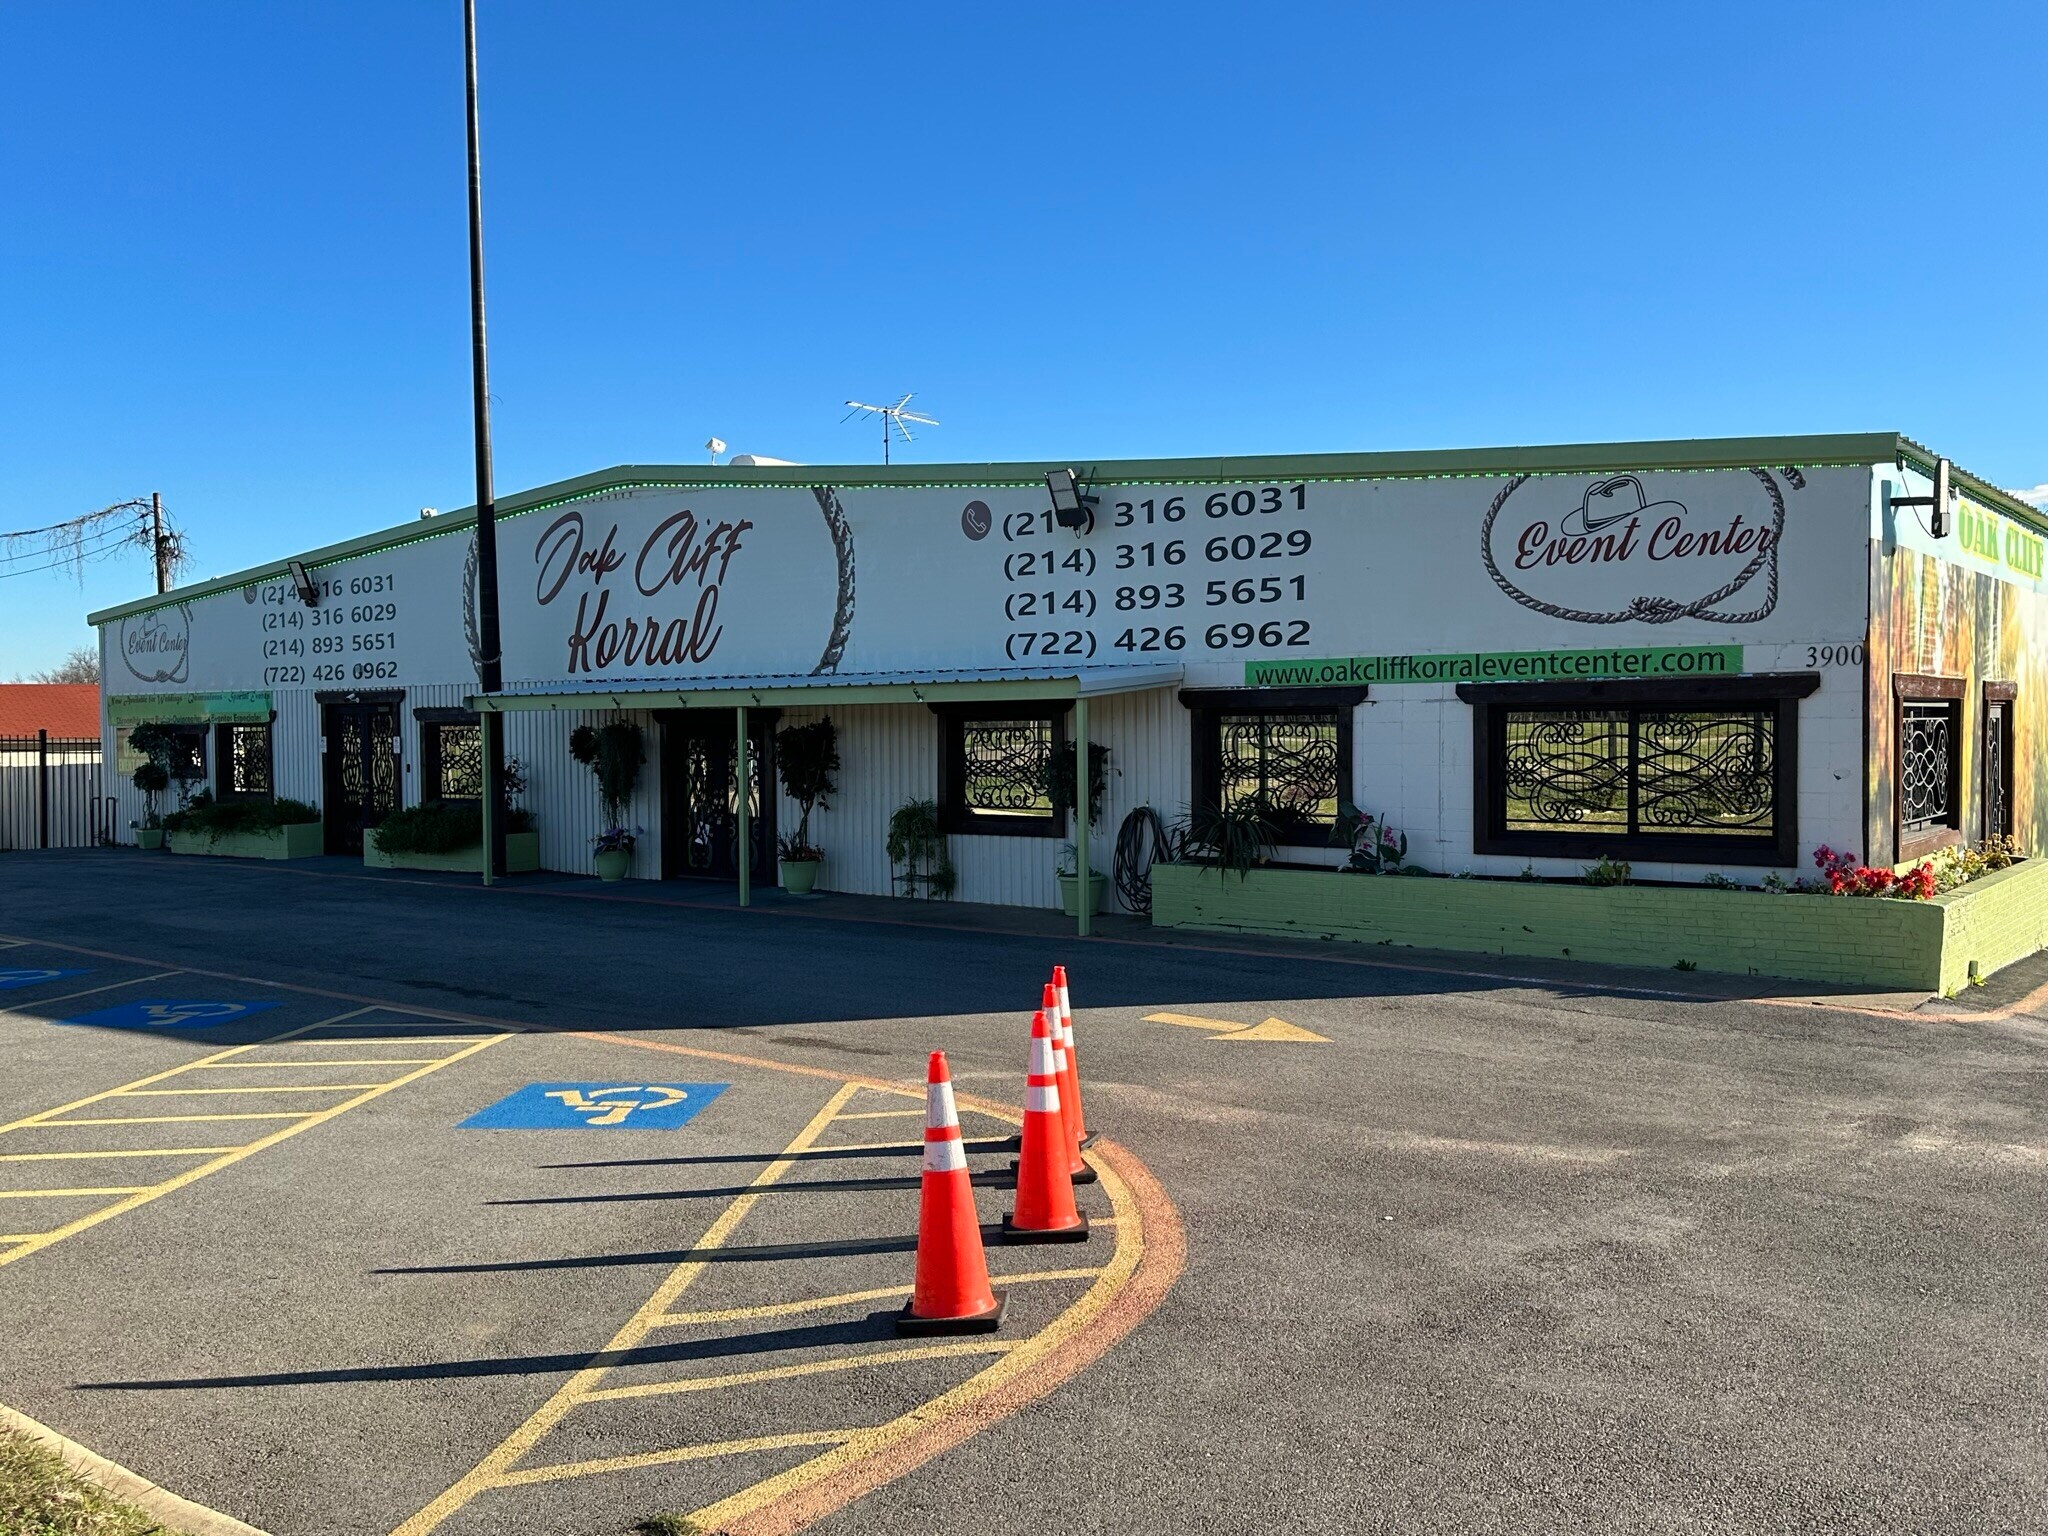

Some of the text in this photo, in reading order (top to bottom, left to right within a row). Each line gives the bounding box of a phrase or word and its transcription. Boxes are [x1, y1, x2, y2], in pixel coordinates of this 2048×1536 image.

[1003, 484, 1306, 541] (21) 316 6031
[1515, 514, 1775, 570] Event Center
[1958, 502, 1999, 561] OAK
[1003, 529, 1312, 581] (214) 316 6029
[351, 574, 394, 595] 6031
[1004, 575, 1306, 621] (214) 893 5651
[262, 603, 396, 632] (214) 316 6029
[568, 585, 723, 674] Korral
[129, 631, 186, 655] Event Center
[263, 632, 395, 659] (214) 893 5651
[1005, 620, 1311, 660] (722) 426 6962
[1805, 645, 1863, 668] 3900
[264, 666, 306, 685] (722)
[313, 664, 345, 681] 426
[1255, 651, 1726, 685] www.oakcliffkorraleventcenter.com
